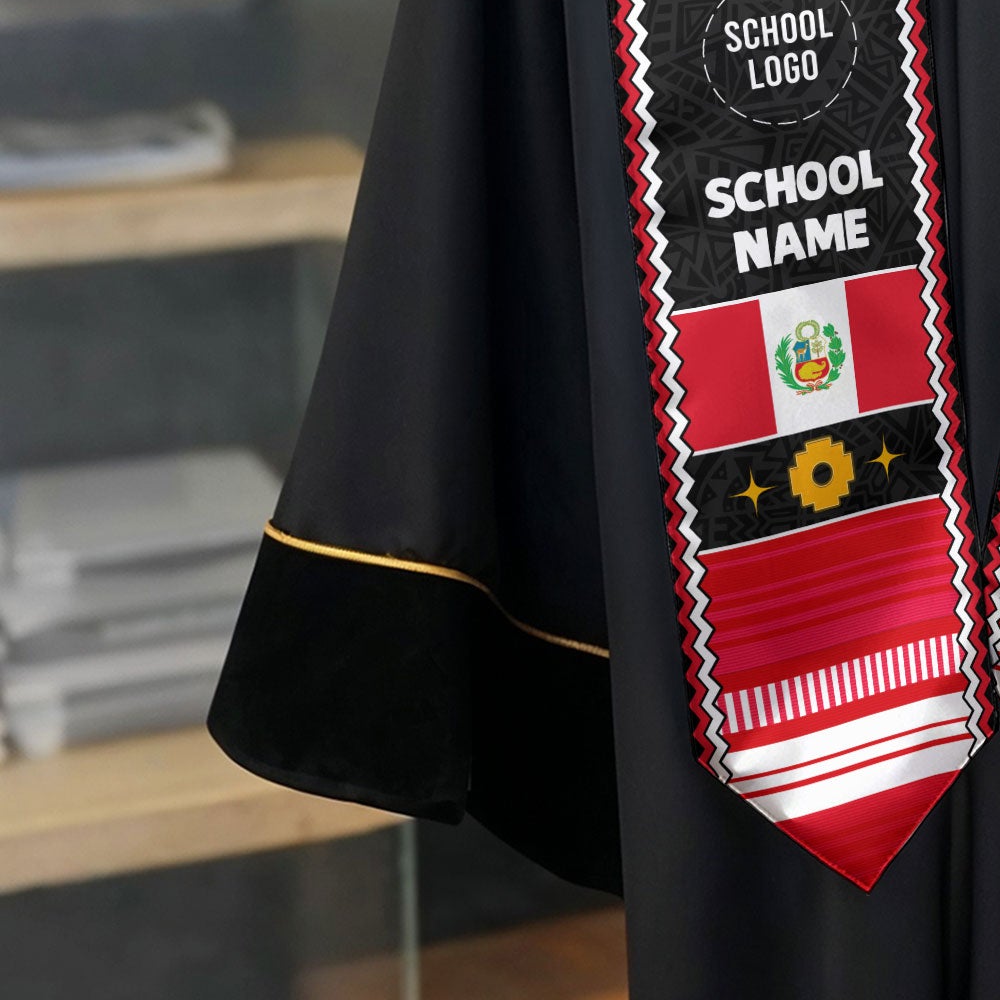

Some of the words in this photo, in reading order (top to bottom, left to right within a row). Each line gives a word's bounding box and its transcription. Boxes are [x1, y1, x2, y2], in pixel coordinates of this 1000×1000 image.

[723, 7, 834, 53] SCHOOL
[747, 49, 819, 90] LOGO
[704, 149, 884, 219] SCHOOL
[732, 207, 870, 274] NAME
